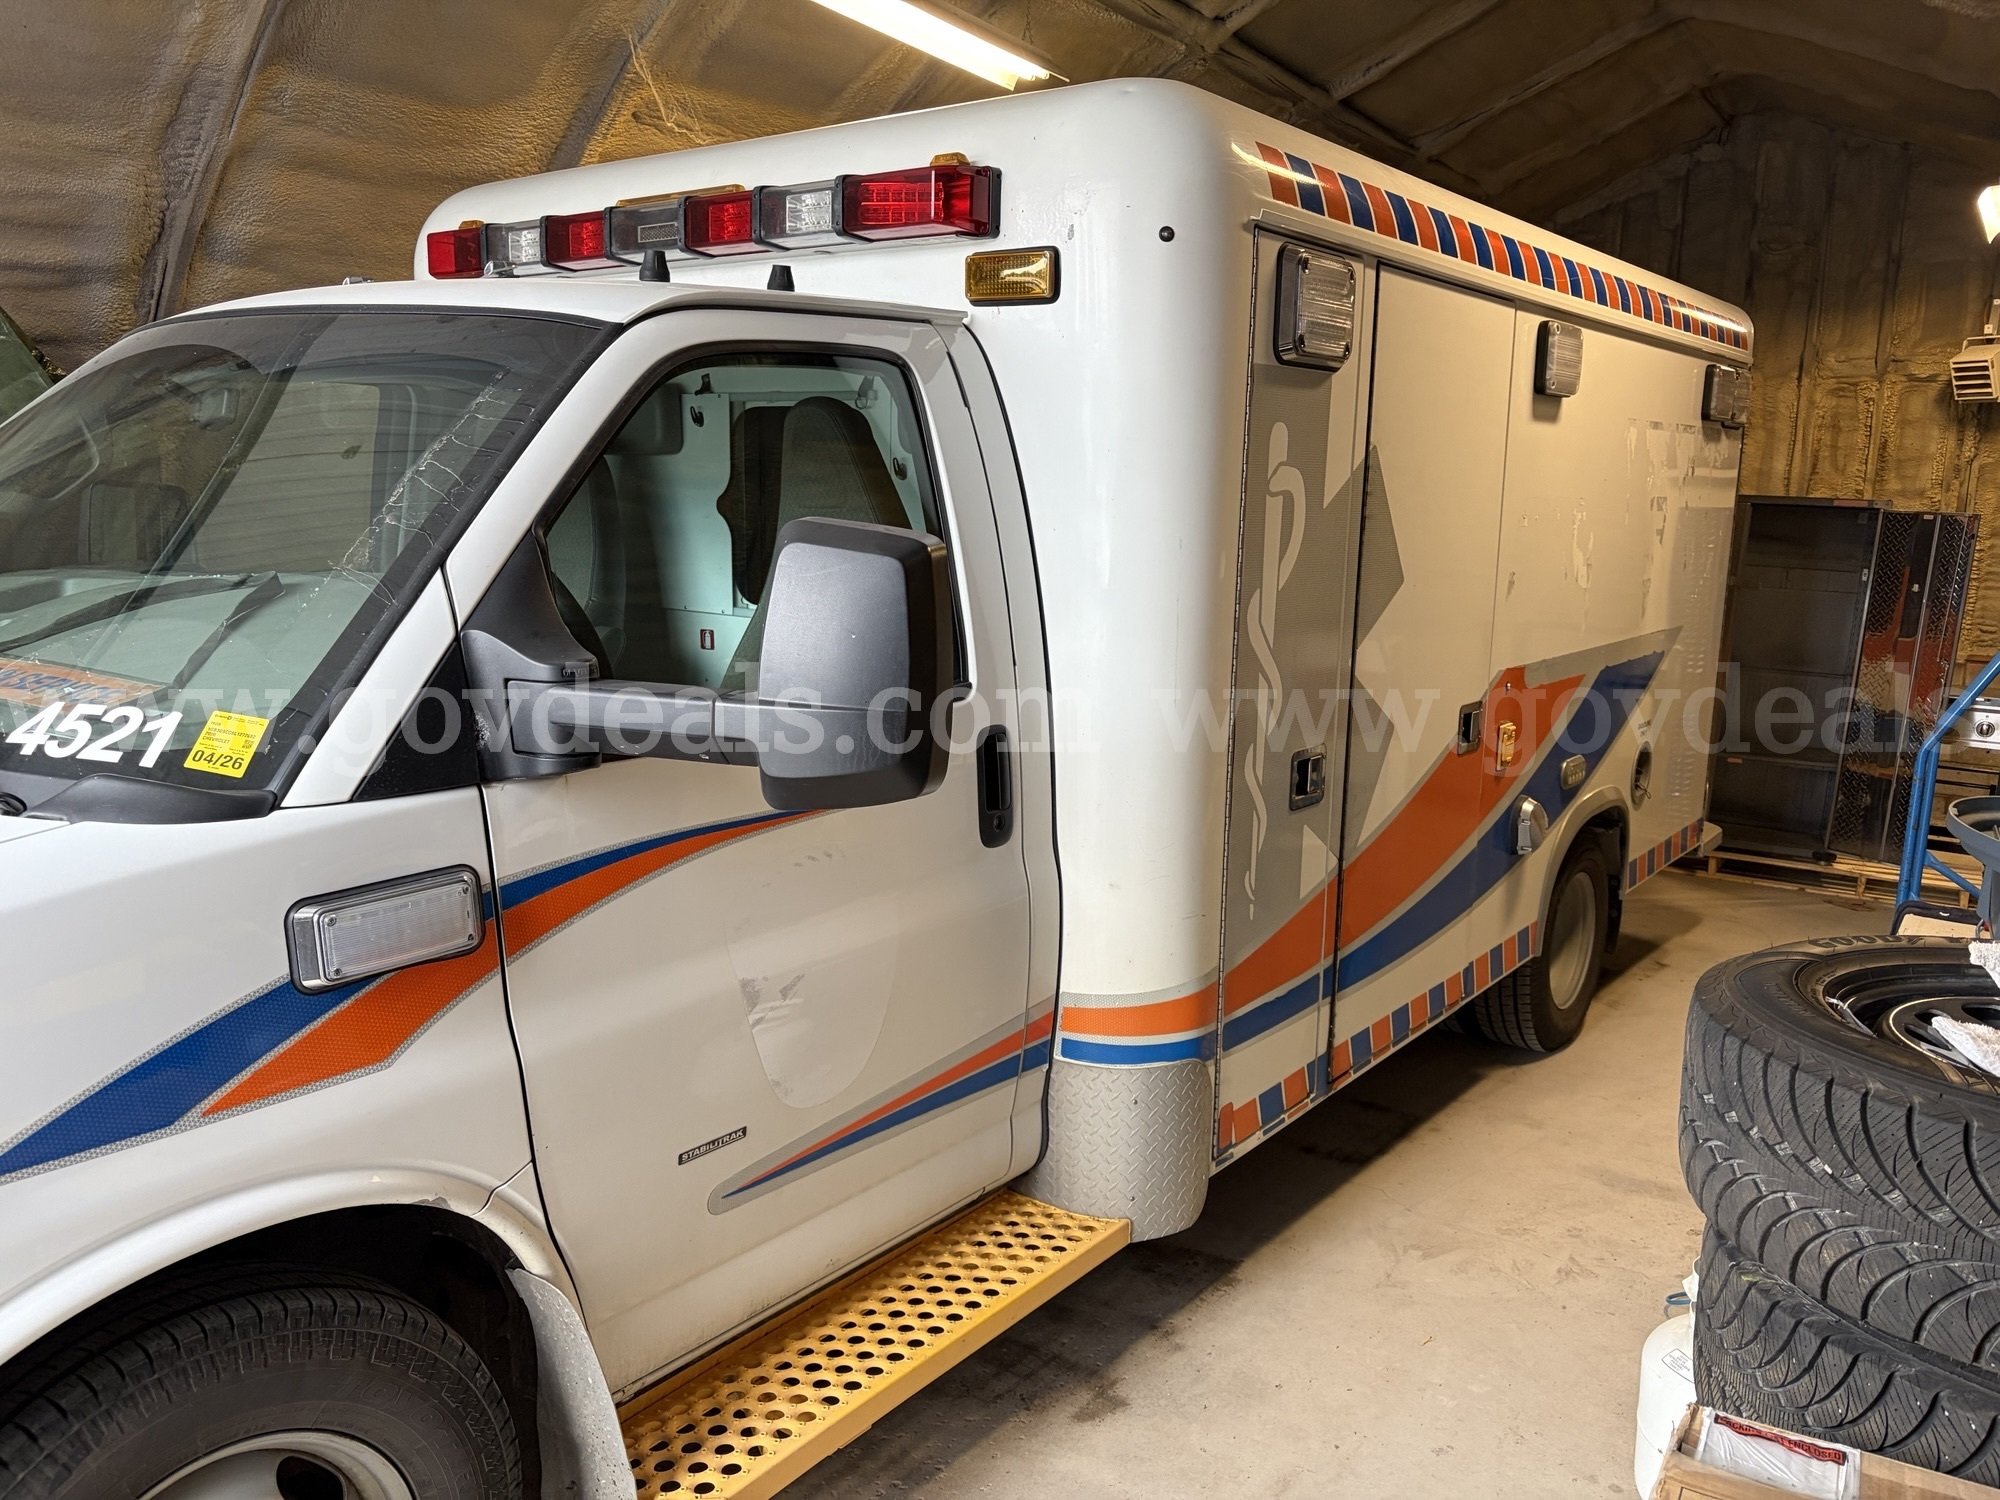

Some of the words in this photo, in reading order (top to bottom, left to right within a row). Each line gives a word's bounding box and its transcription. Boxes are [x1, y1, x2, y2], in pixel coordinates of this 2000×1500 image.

[5, 701, 183, 768] 4521
[192, 750, 244, 770] 04/26
[682, 1128, 744, 1161] STABILITRAK
